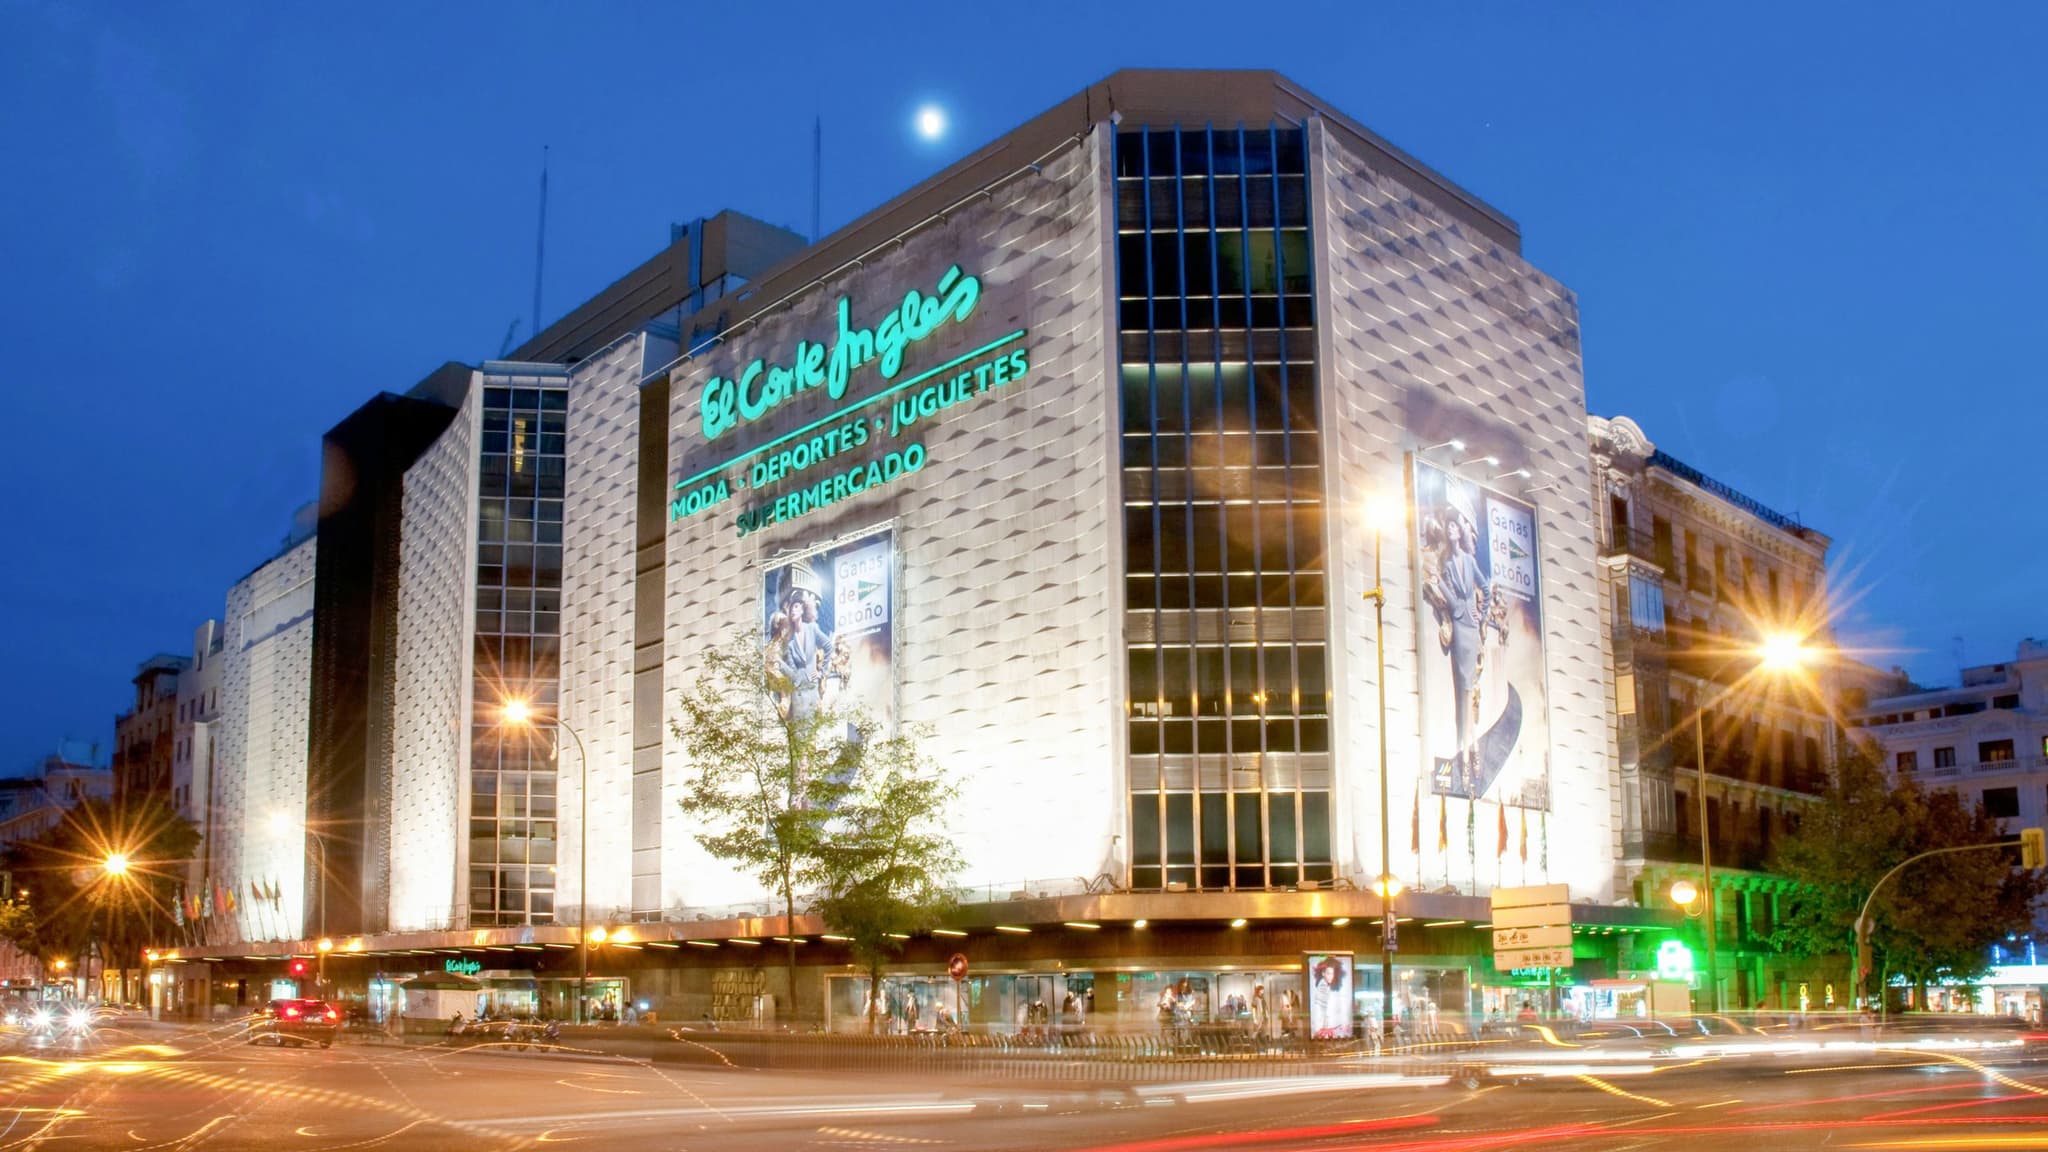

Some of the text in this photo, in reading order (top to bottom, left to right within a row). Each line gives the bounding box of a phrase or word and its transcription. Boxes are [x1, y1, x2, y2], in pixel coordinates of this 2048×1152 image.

[700, 264, 981, 440] El Corte Inglés
[671, 347, 1029, 522] MODA DEPORTES JUGUETES
[736, 442, 926, 539] SUPERMERCADO
[1491, 507, 1529, 538] Ganas
[1492, 533, 1507, 555] de
[839, 554, 884, 579] Ganas
[1494, 563, 1532, 587] otoño
[839, 585, 856, 605] de
[839, 602, 884, 627] otoño
